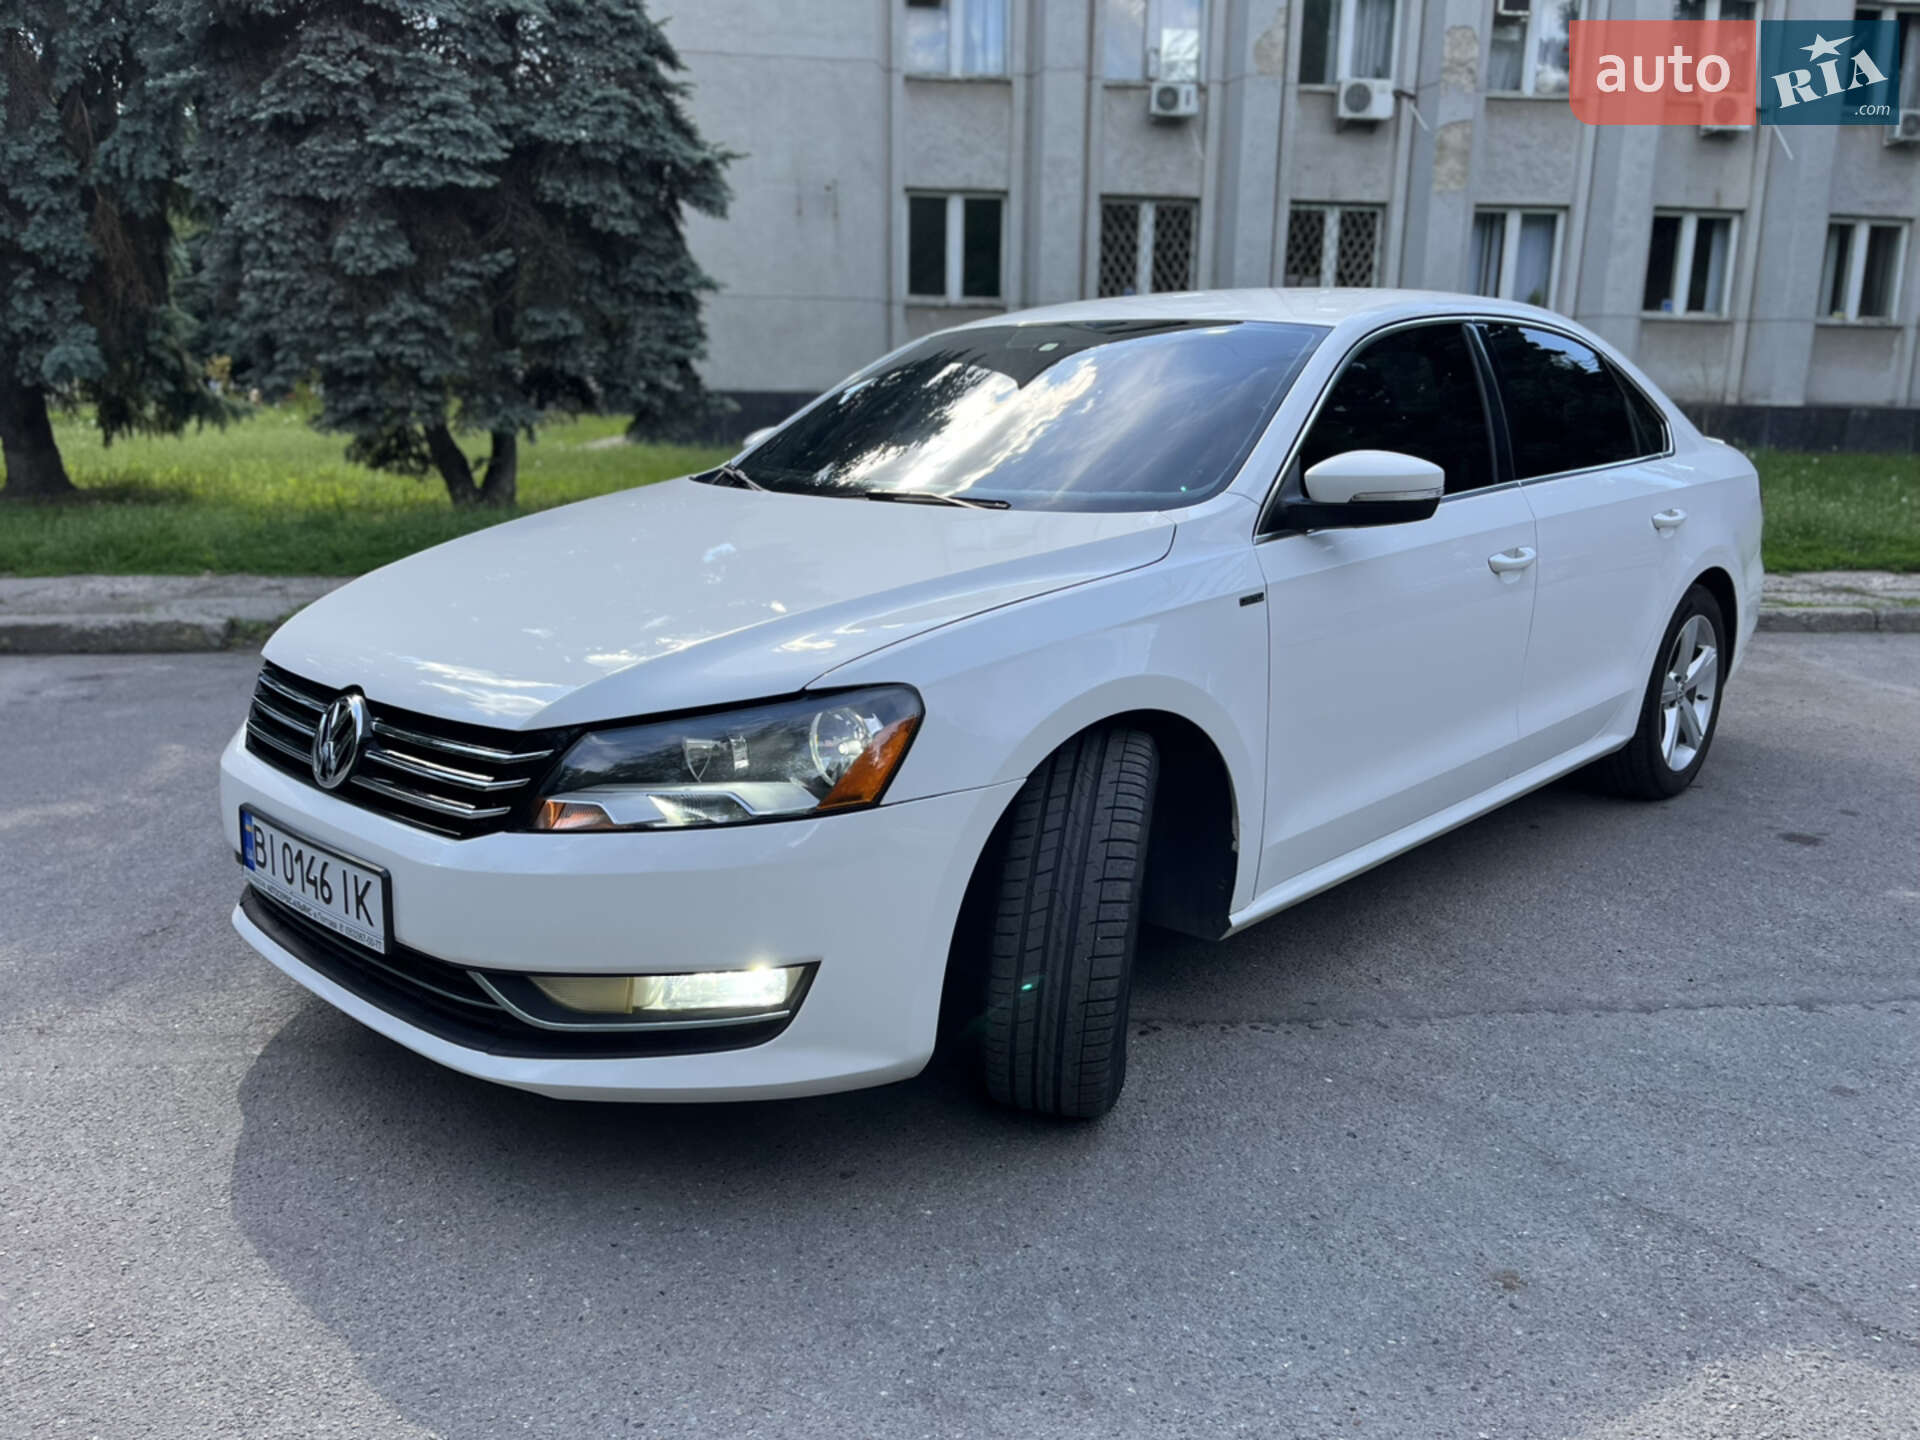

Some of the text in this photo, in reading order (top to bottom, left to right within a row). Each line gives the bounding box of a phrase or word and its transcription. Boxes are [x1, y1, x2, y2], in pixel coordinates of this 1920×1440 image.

[254, 824, 276, 877] BI
[282, 841, 333, 905] 0146
[342, 869, 375, 927] IK
